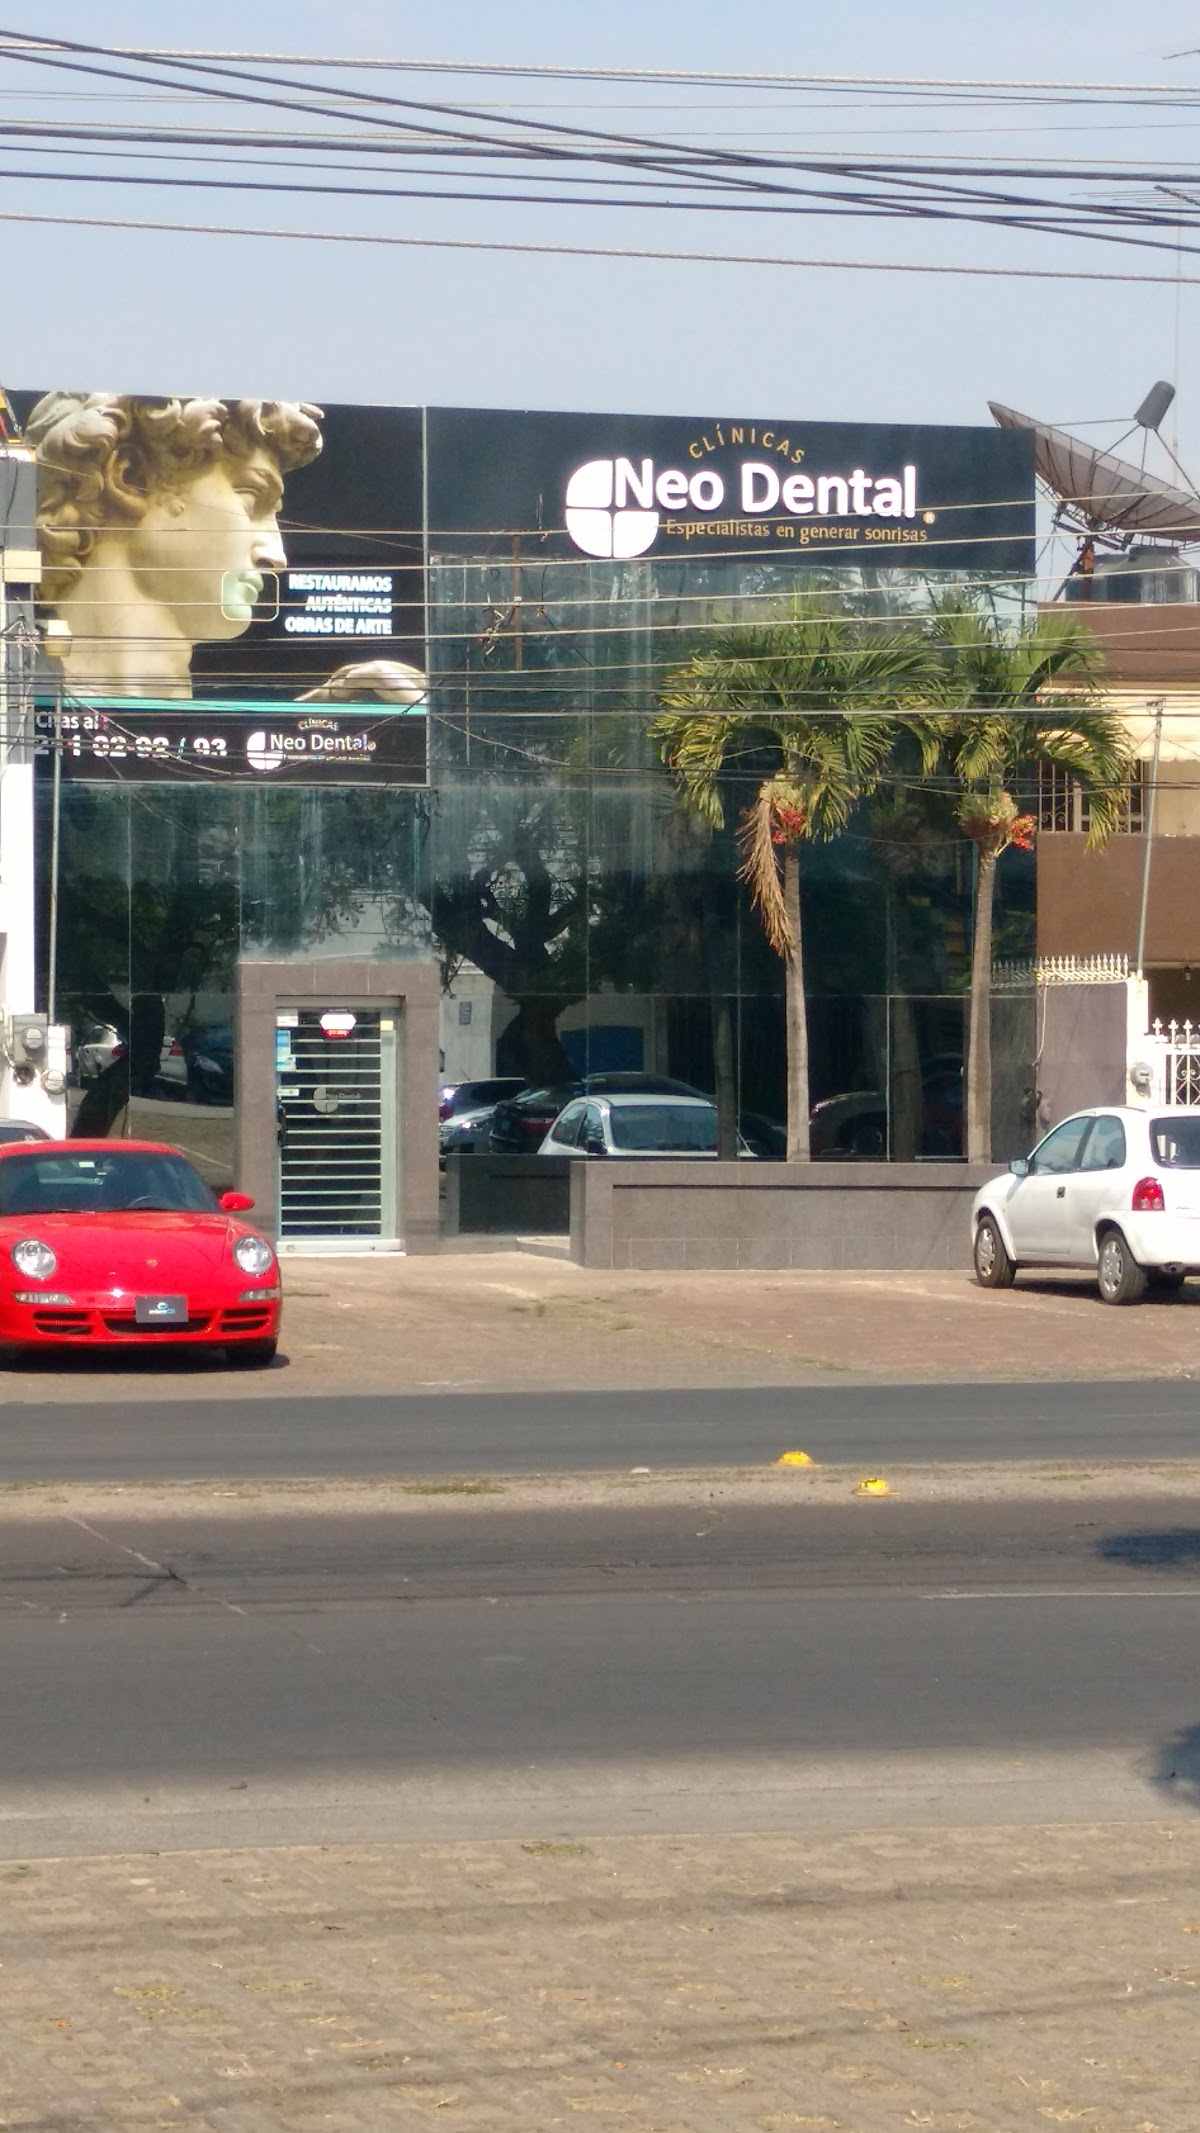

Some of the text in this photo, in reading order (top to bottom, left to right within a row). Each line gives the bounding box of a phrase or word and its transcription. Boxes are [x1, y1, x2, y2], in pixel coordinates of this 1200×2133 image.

[689, 423, 805, 464] CLÍNICAS
[615, 457, 916, 518] Neo Dental
[666, 519, 927, 544] Especialistas en generar sonrisas
[288, 573, 393, 592] RESTAURAMOS
[305, 594, 393, 613] AUTÉNTICAS
[284, 616, 393, 635] OBRAS DE ARTE
[270, 734, 367, 751] Neo Dental
